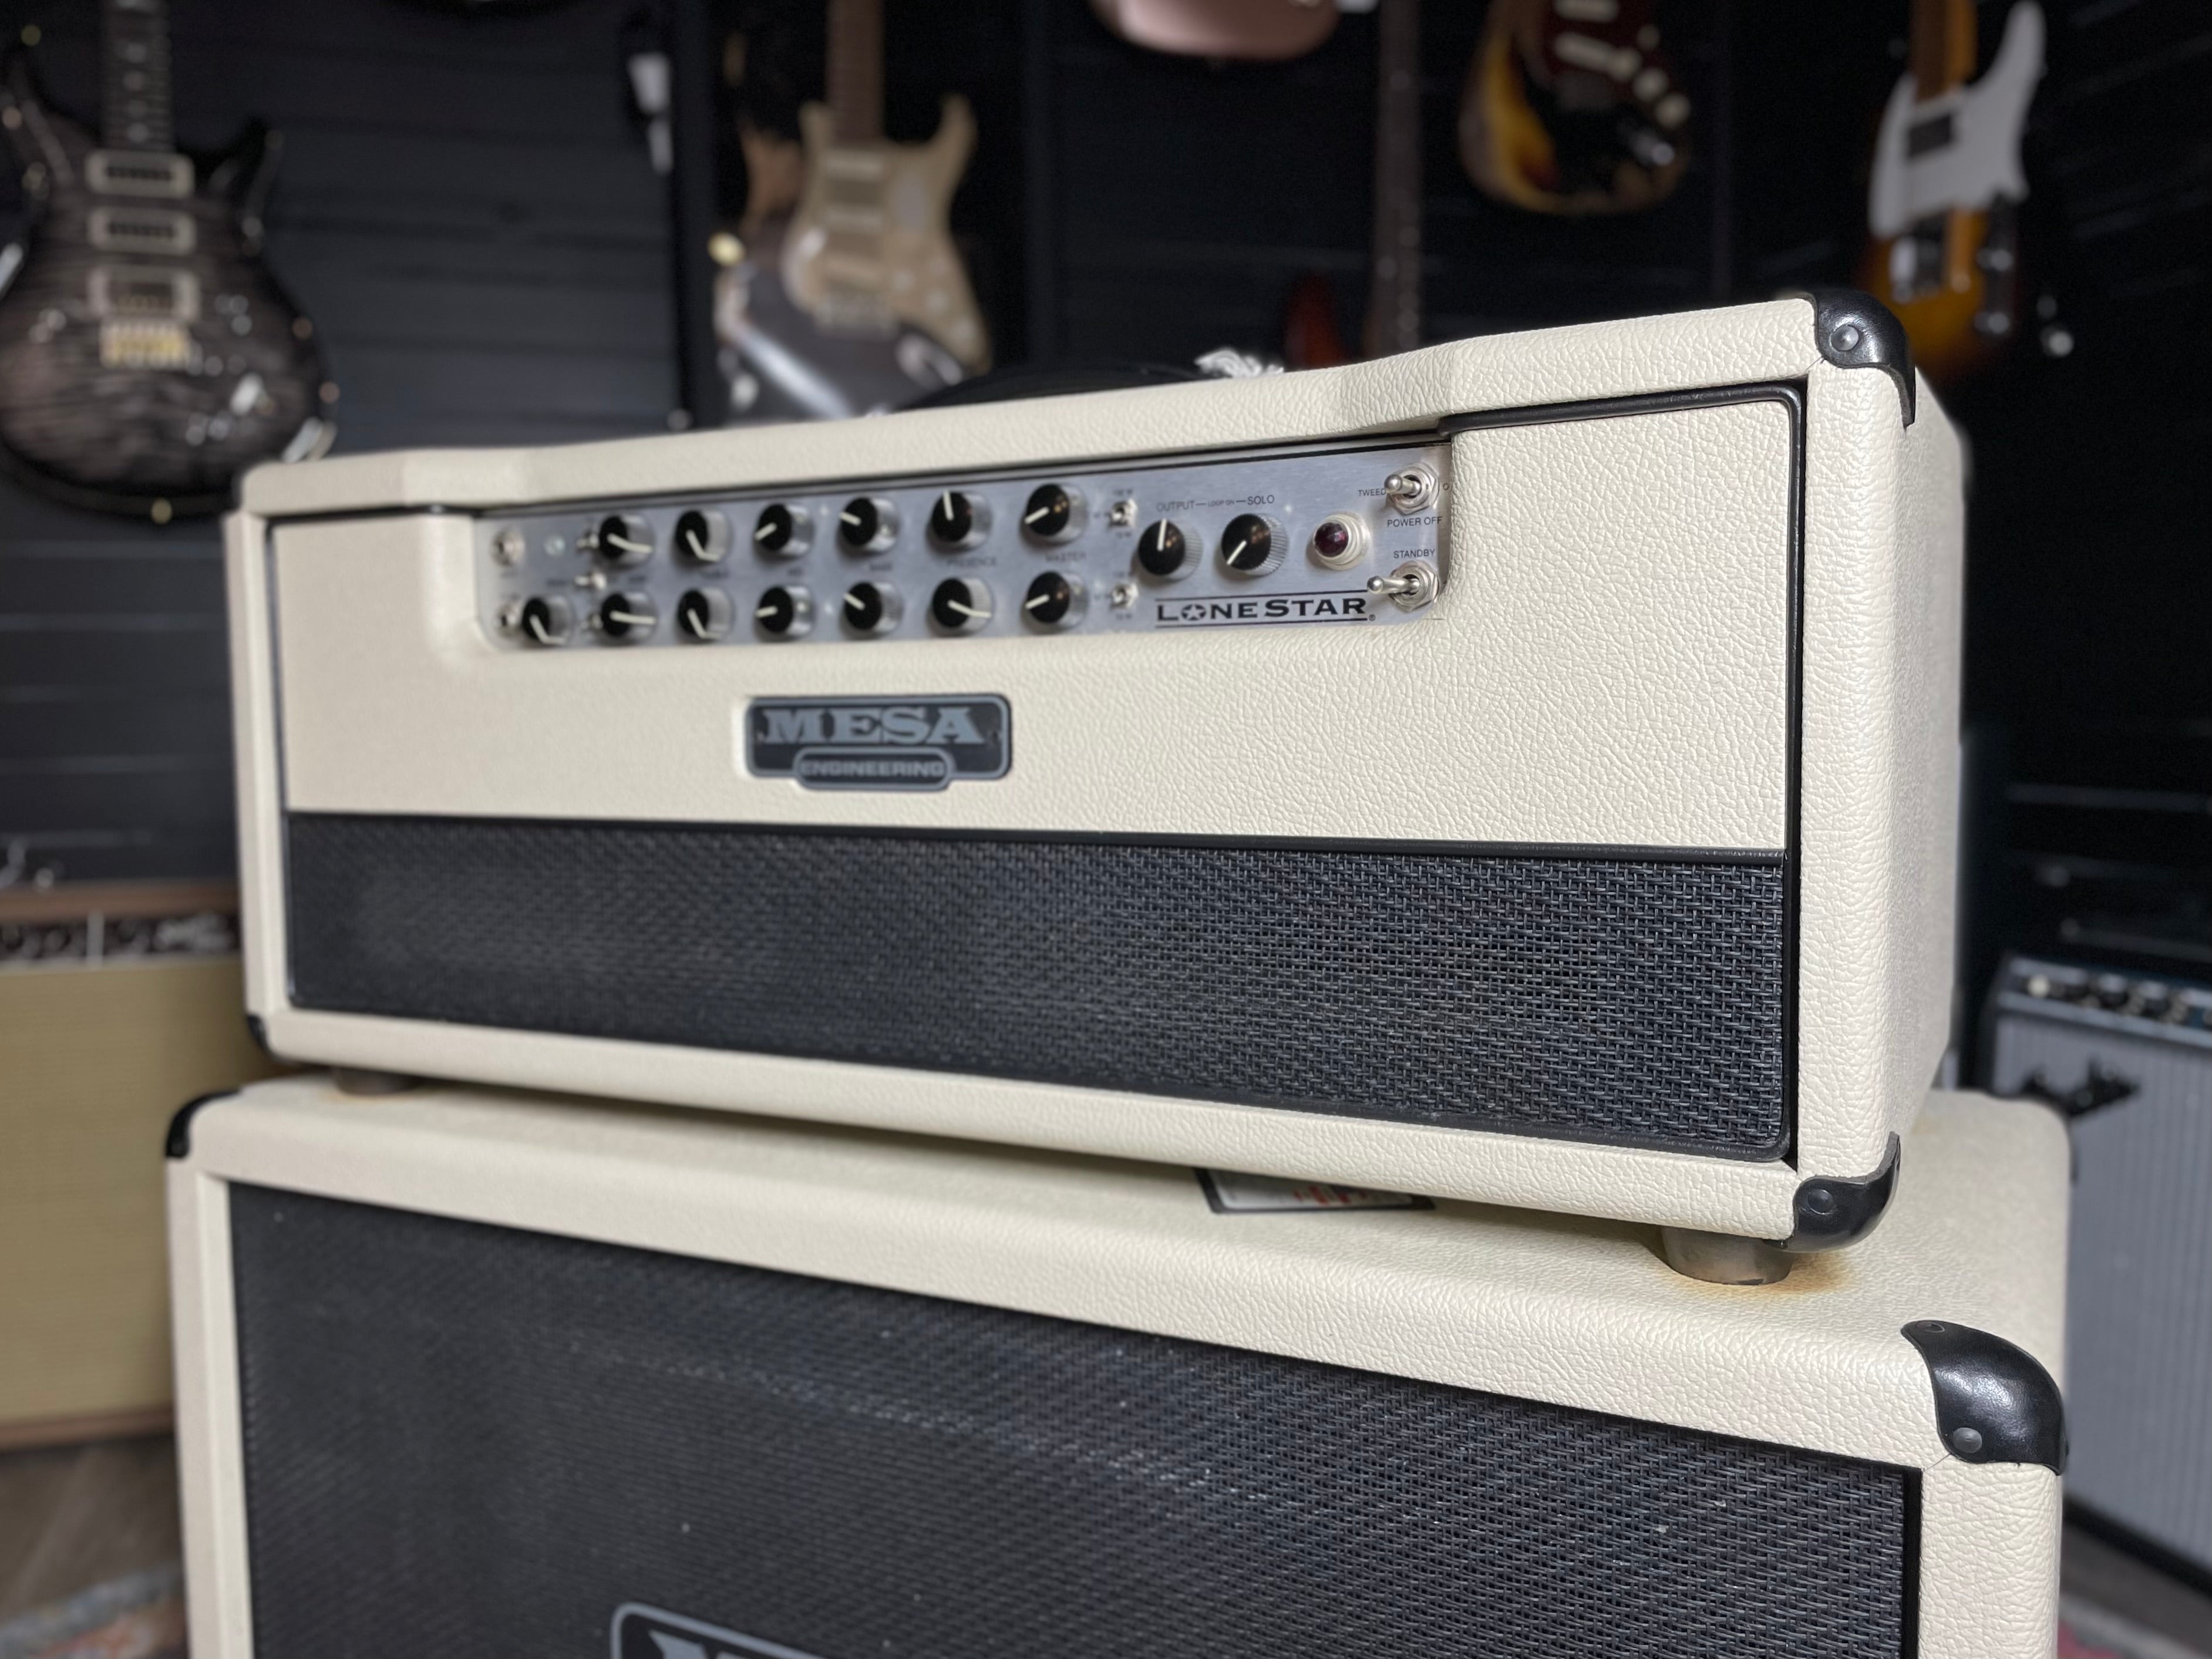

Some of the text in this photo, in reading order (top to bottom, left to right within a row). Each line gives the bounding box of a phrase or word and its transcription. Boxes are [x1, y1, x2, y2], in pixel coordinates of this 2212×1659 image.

[1358, 488, 1386, 497] TWEED
[1156, 500, 1195, 512] OUTPUT
[1247, 494, 1275, 506] SOLO
[1387, 516, 1443, 527] POWER OFF
[1393, 548, 1435, 558] STANDBY
[763, 706, 985, 745] MESA
